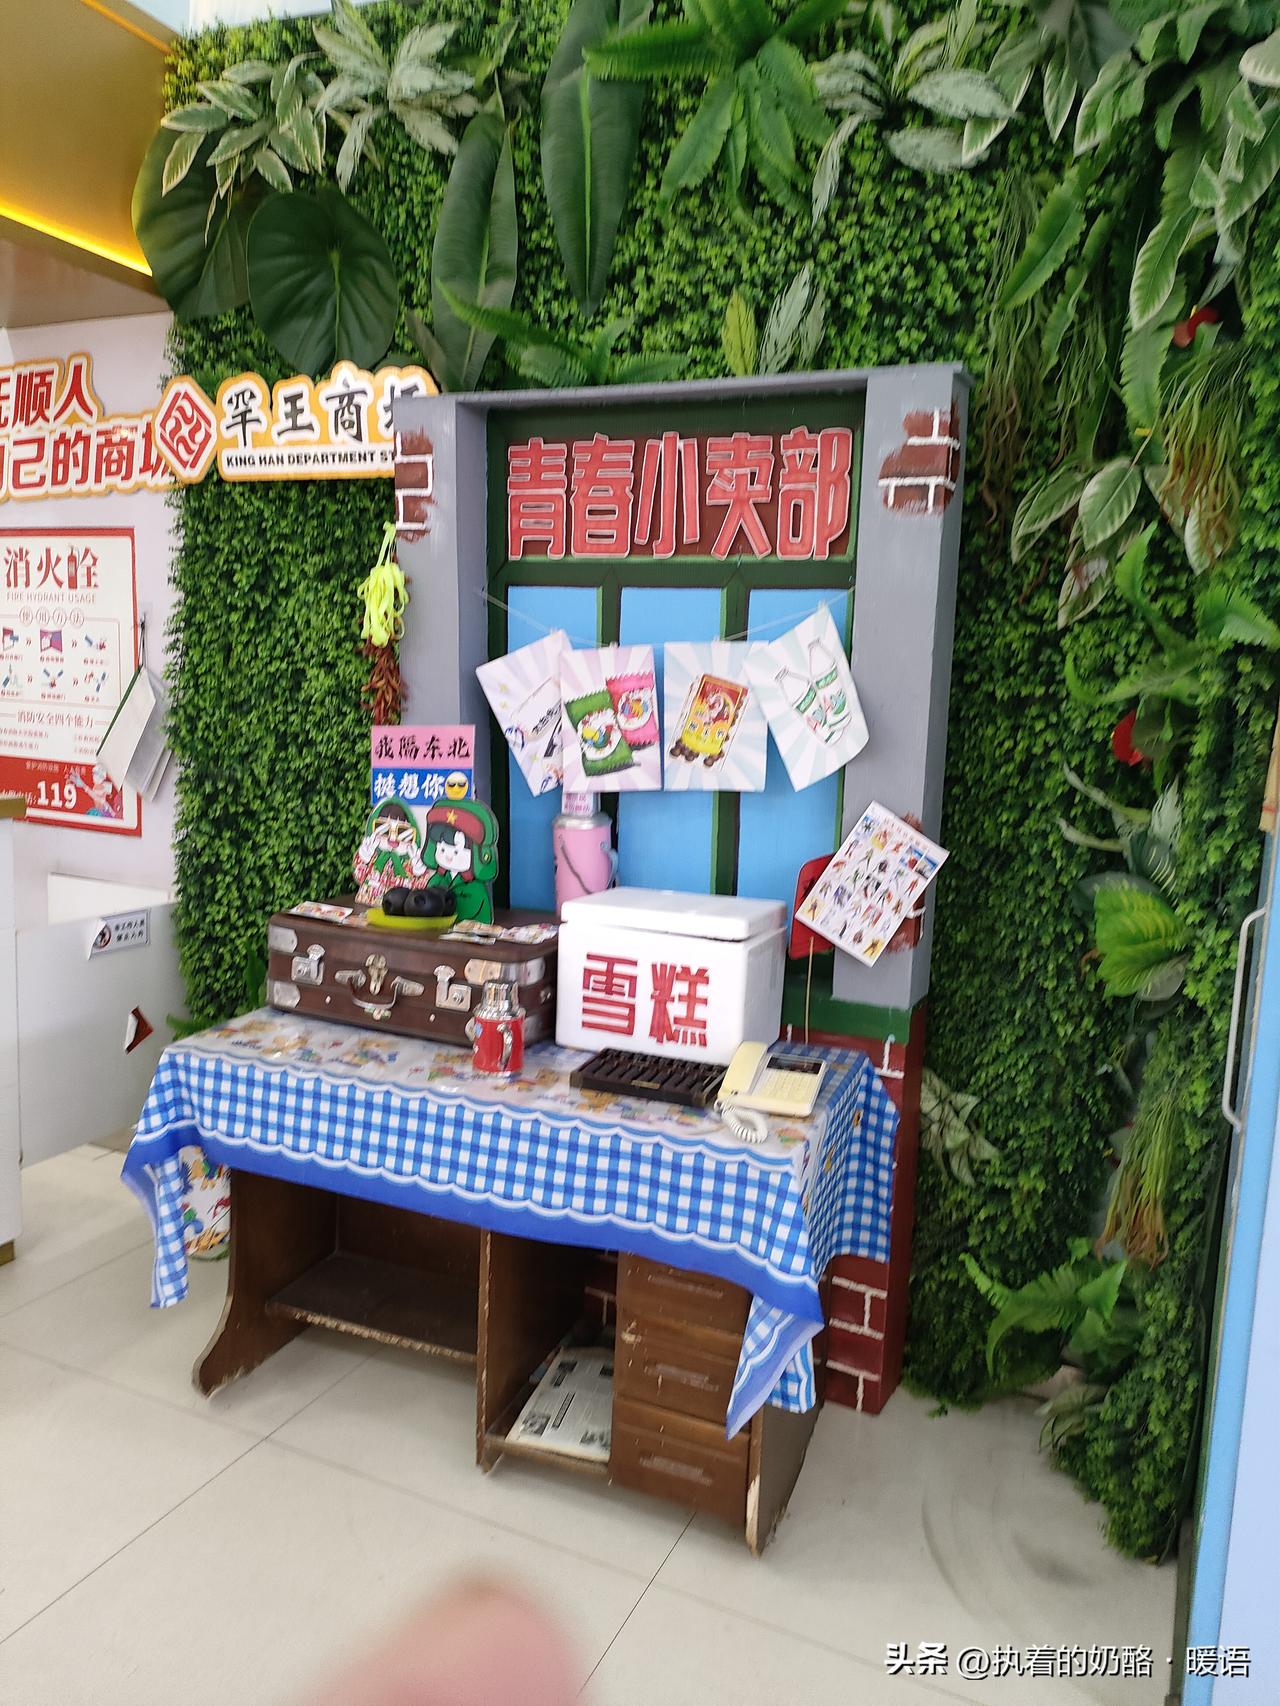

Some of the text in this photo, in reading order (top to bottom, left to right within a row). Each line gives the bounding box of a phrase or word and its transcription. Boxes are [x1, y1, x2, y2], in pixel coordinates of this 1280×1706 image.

[0, 422, 170, 490] 己的商
[226, 455, 256, 468] KING
[258, 455, 285, 467] HAN
[287, 452, 375, 466] DEPARTMENT
[507, 426, 853, 561] 青春小卖部
[4, 545, 99, 590] 消火栓
[375, 734, 471, 761] 我隔东北
[37, 780, 77, 809] 119
[373, 772, 446, 799] 挺想你
[581, 952, 710, 1048] 雪糕
